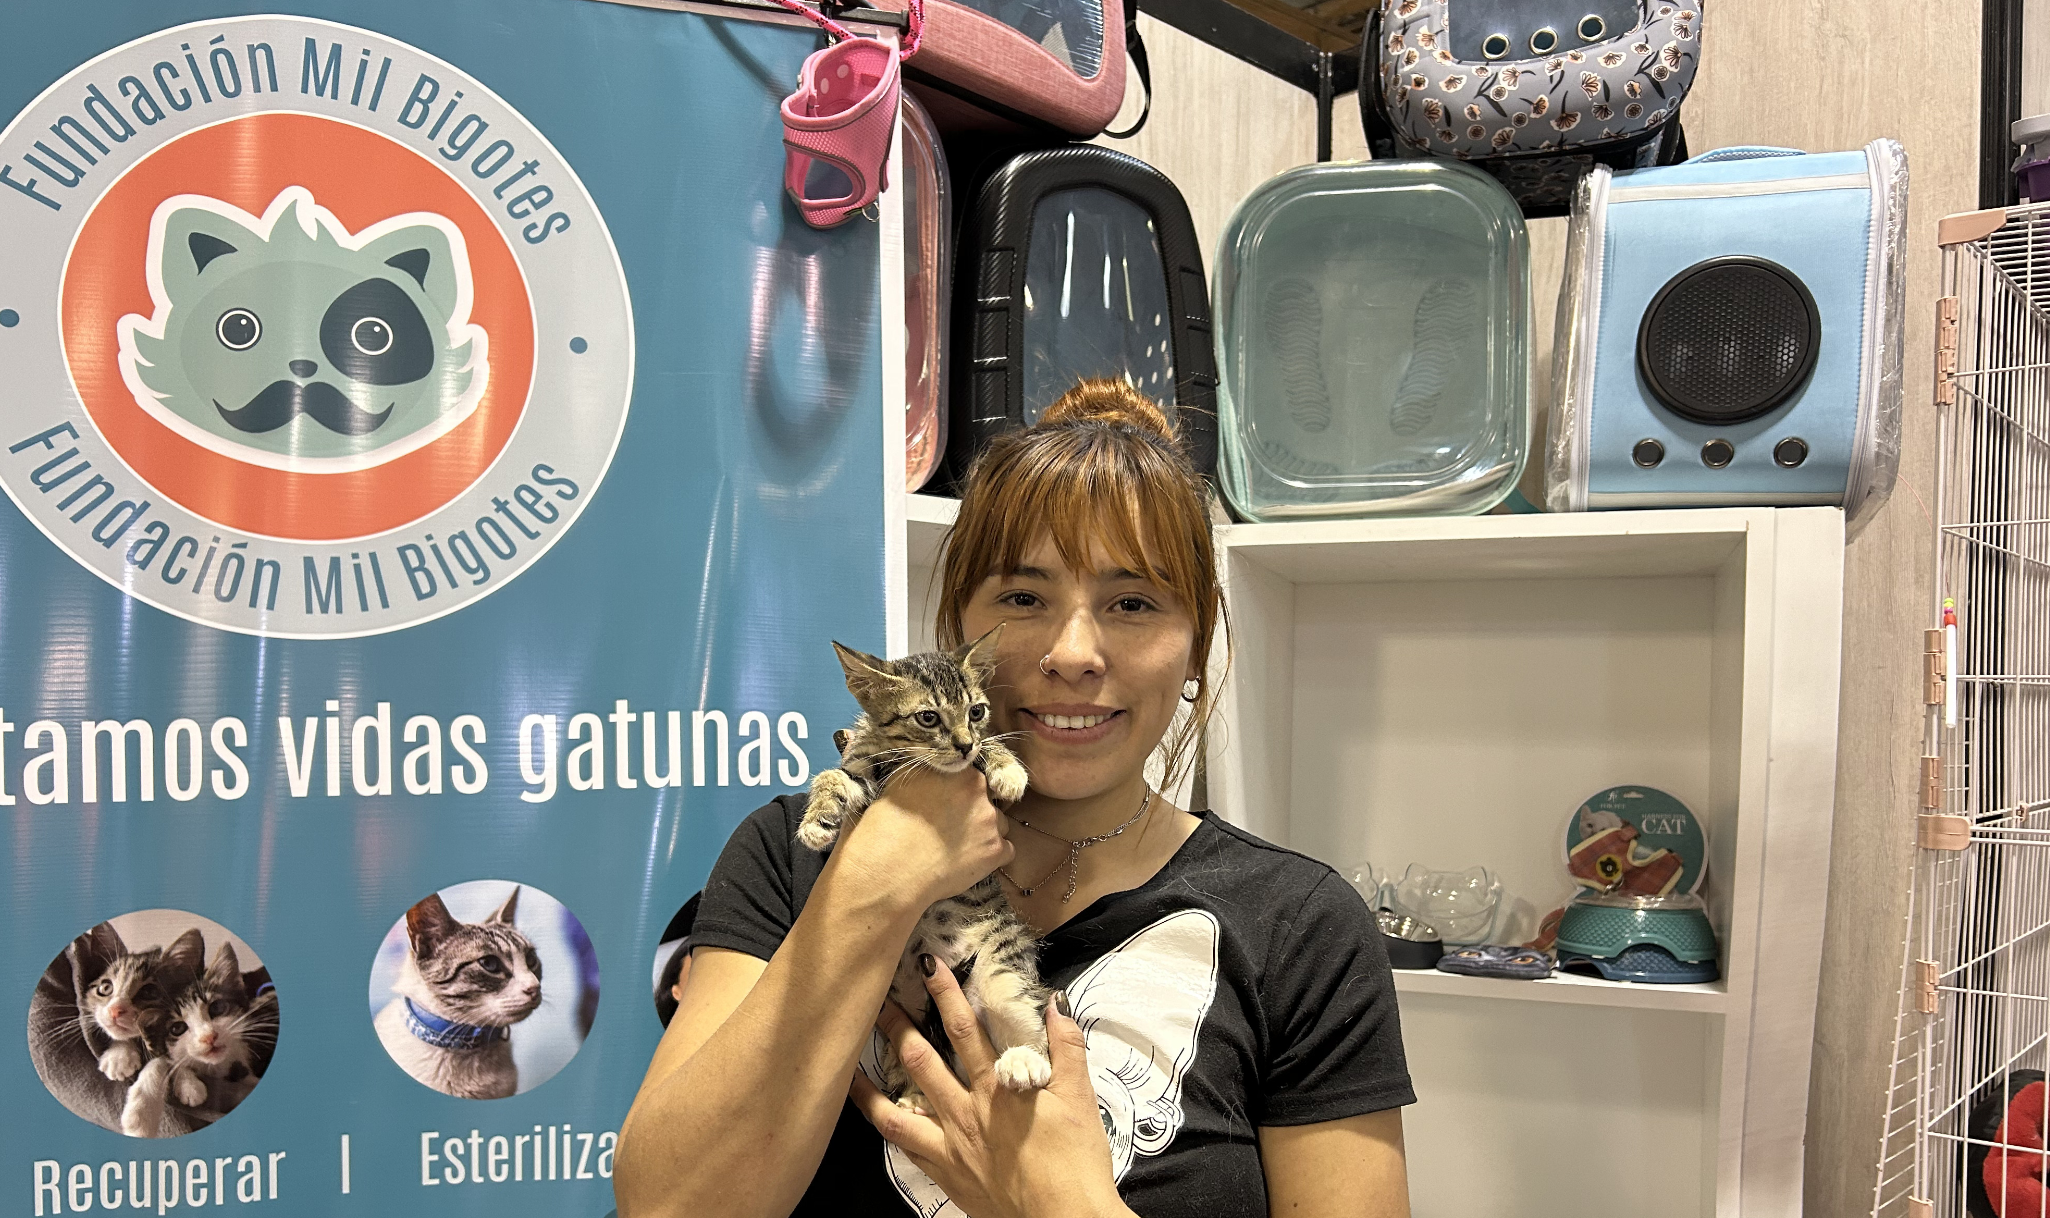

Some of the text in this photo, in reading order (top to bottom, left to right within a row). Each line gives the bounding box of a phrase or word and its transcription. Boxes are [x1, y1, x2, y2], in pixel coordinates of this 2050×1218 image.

[0, 34, 571, 245] Fundación Mil Bigotes
[9, 421, 580, 615] Fundación Mil Bigotes
[279, 701, 489, 798] vidas
[516, 698, 811, 803] gatunas
[1641, 819, 1687, 835] CAT
[34, 1152, 286, 1217] Recuperar
